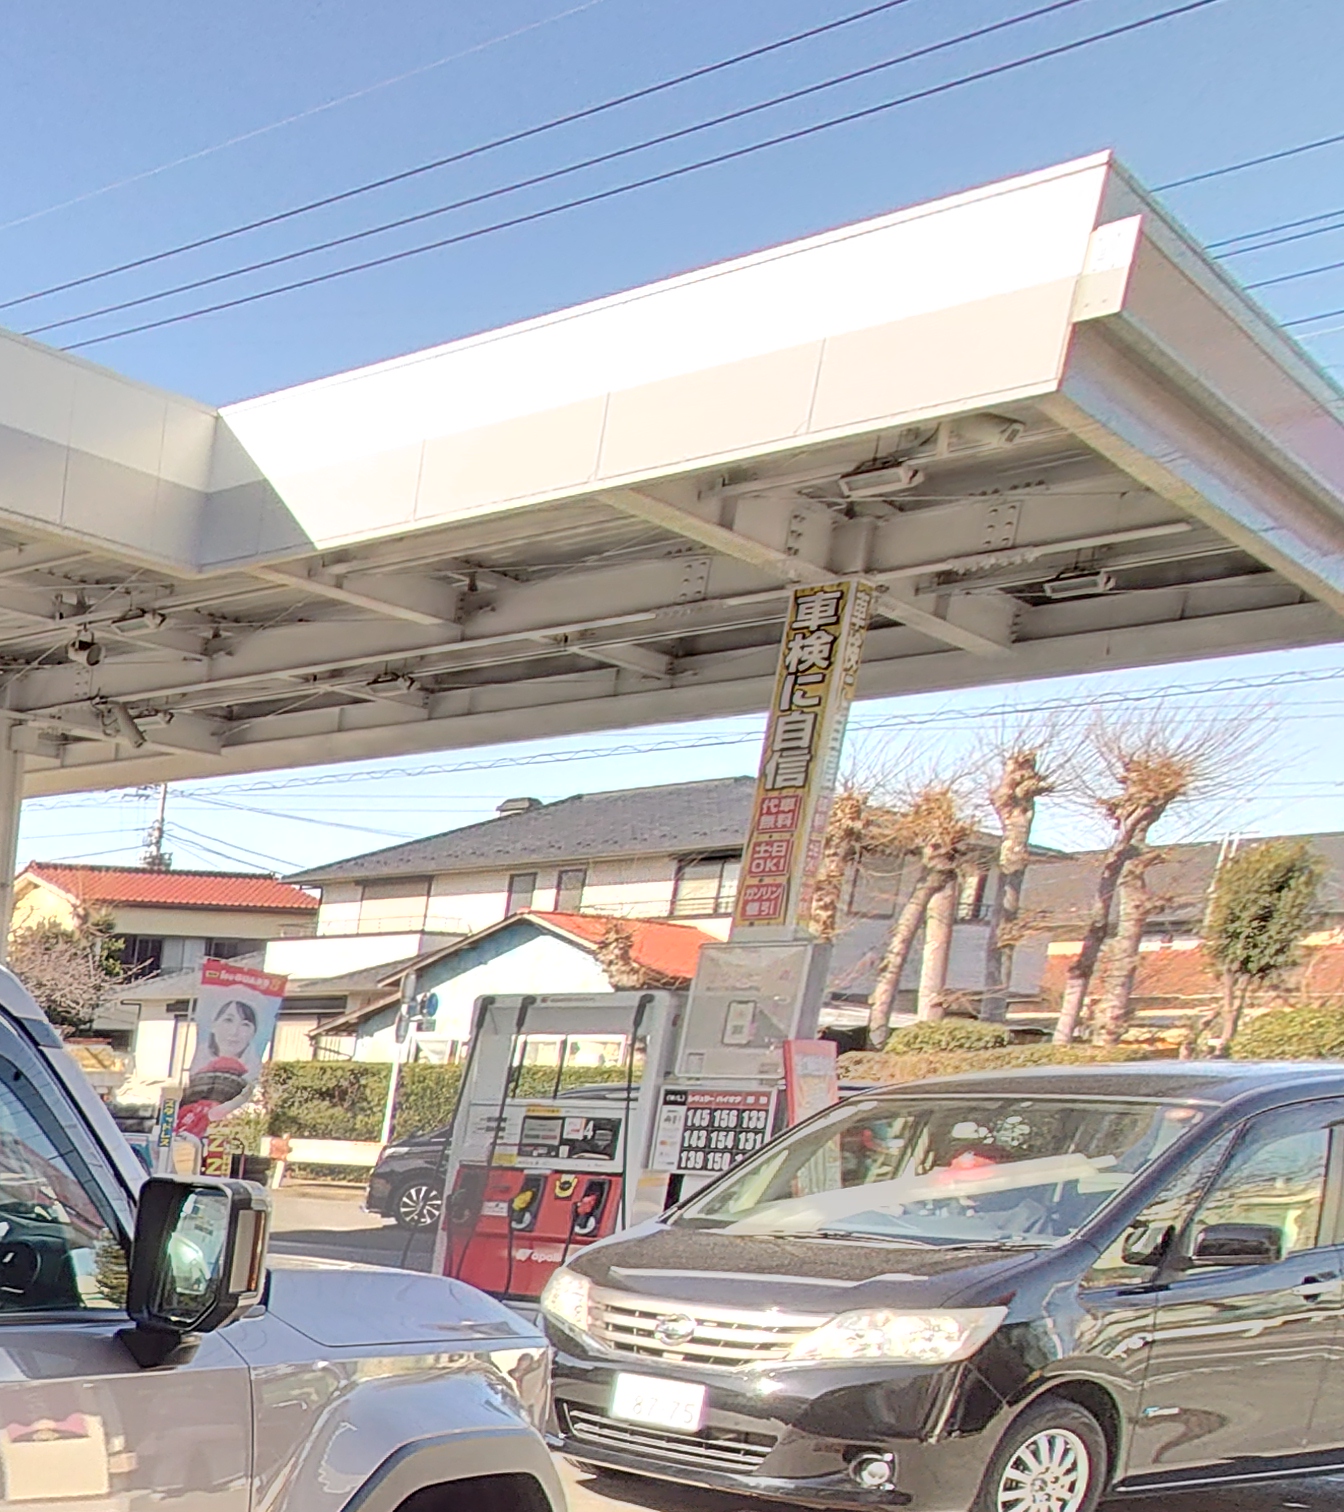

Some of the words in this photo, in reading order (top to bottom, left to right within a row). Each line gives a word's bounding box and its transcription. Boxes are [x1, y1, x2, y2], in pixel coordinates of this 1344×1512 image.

[763, 588, 843, 791] 車検に自信
[687, 1109, 710, 1127] 145
[713, 1110, 737, 1128] 156
[742, 1110, 766, 1129] 133
[683, 1130, 707, 1148] 143
[710, 1131, 734, 1149] 154
[738, 1132, 763, 1150] 131
[680, 1151, 704, 1169] 139
[707, 1152, 731, 1170] 150
